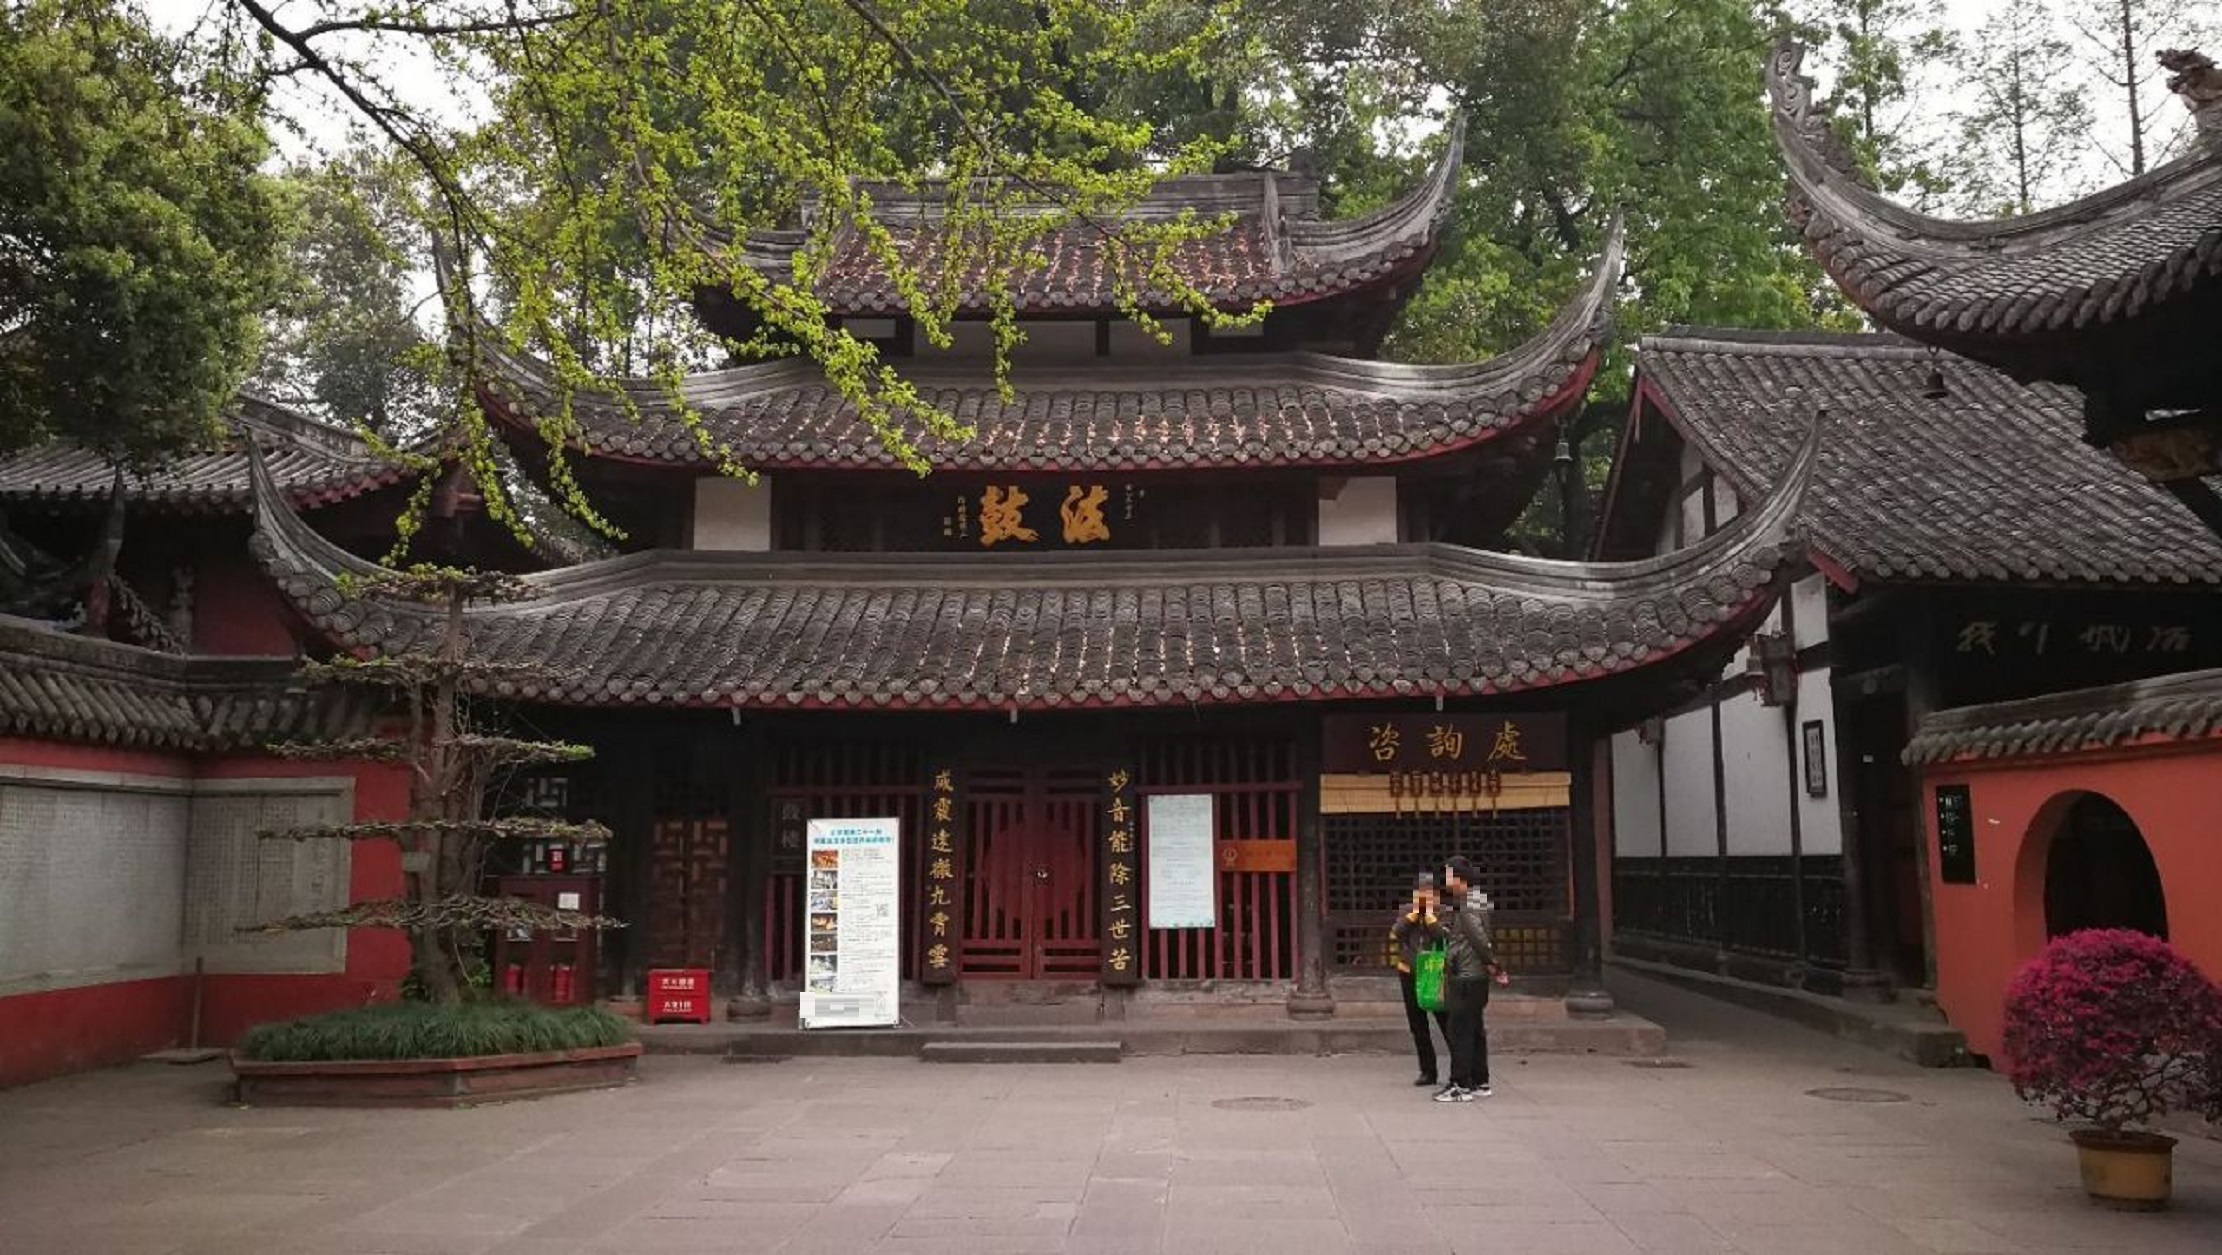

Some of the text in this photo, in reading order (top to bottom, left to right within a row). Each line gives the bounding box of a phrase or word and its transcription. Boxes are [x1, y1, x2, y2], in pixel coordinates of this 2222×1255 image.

[1108, 767, 1131, 970] 妙音能除三世苦
